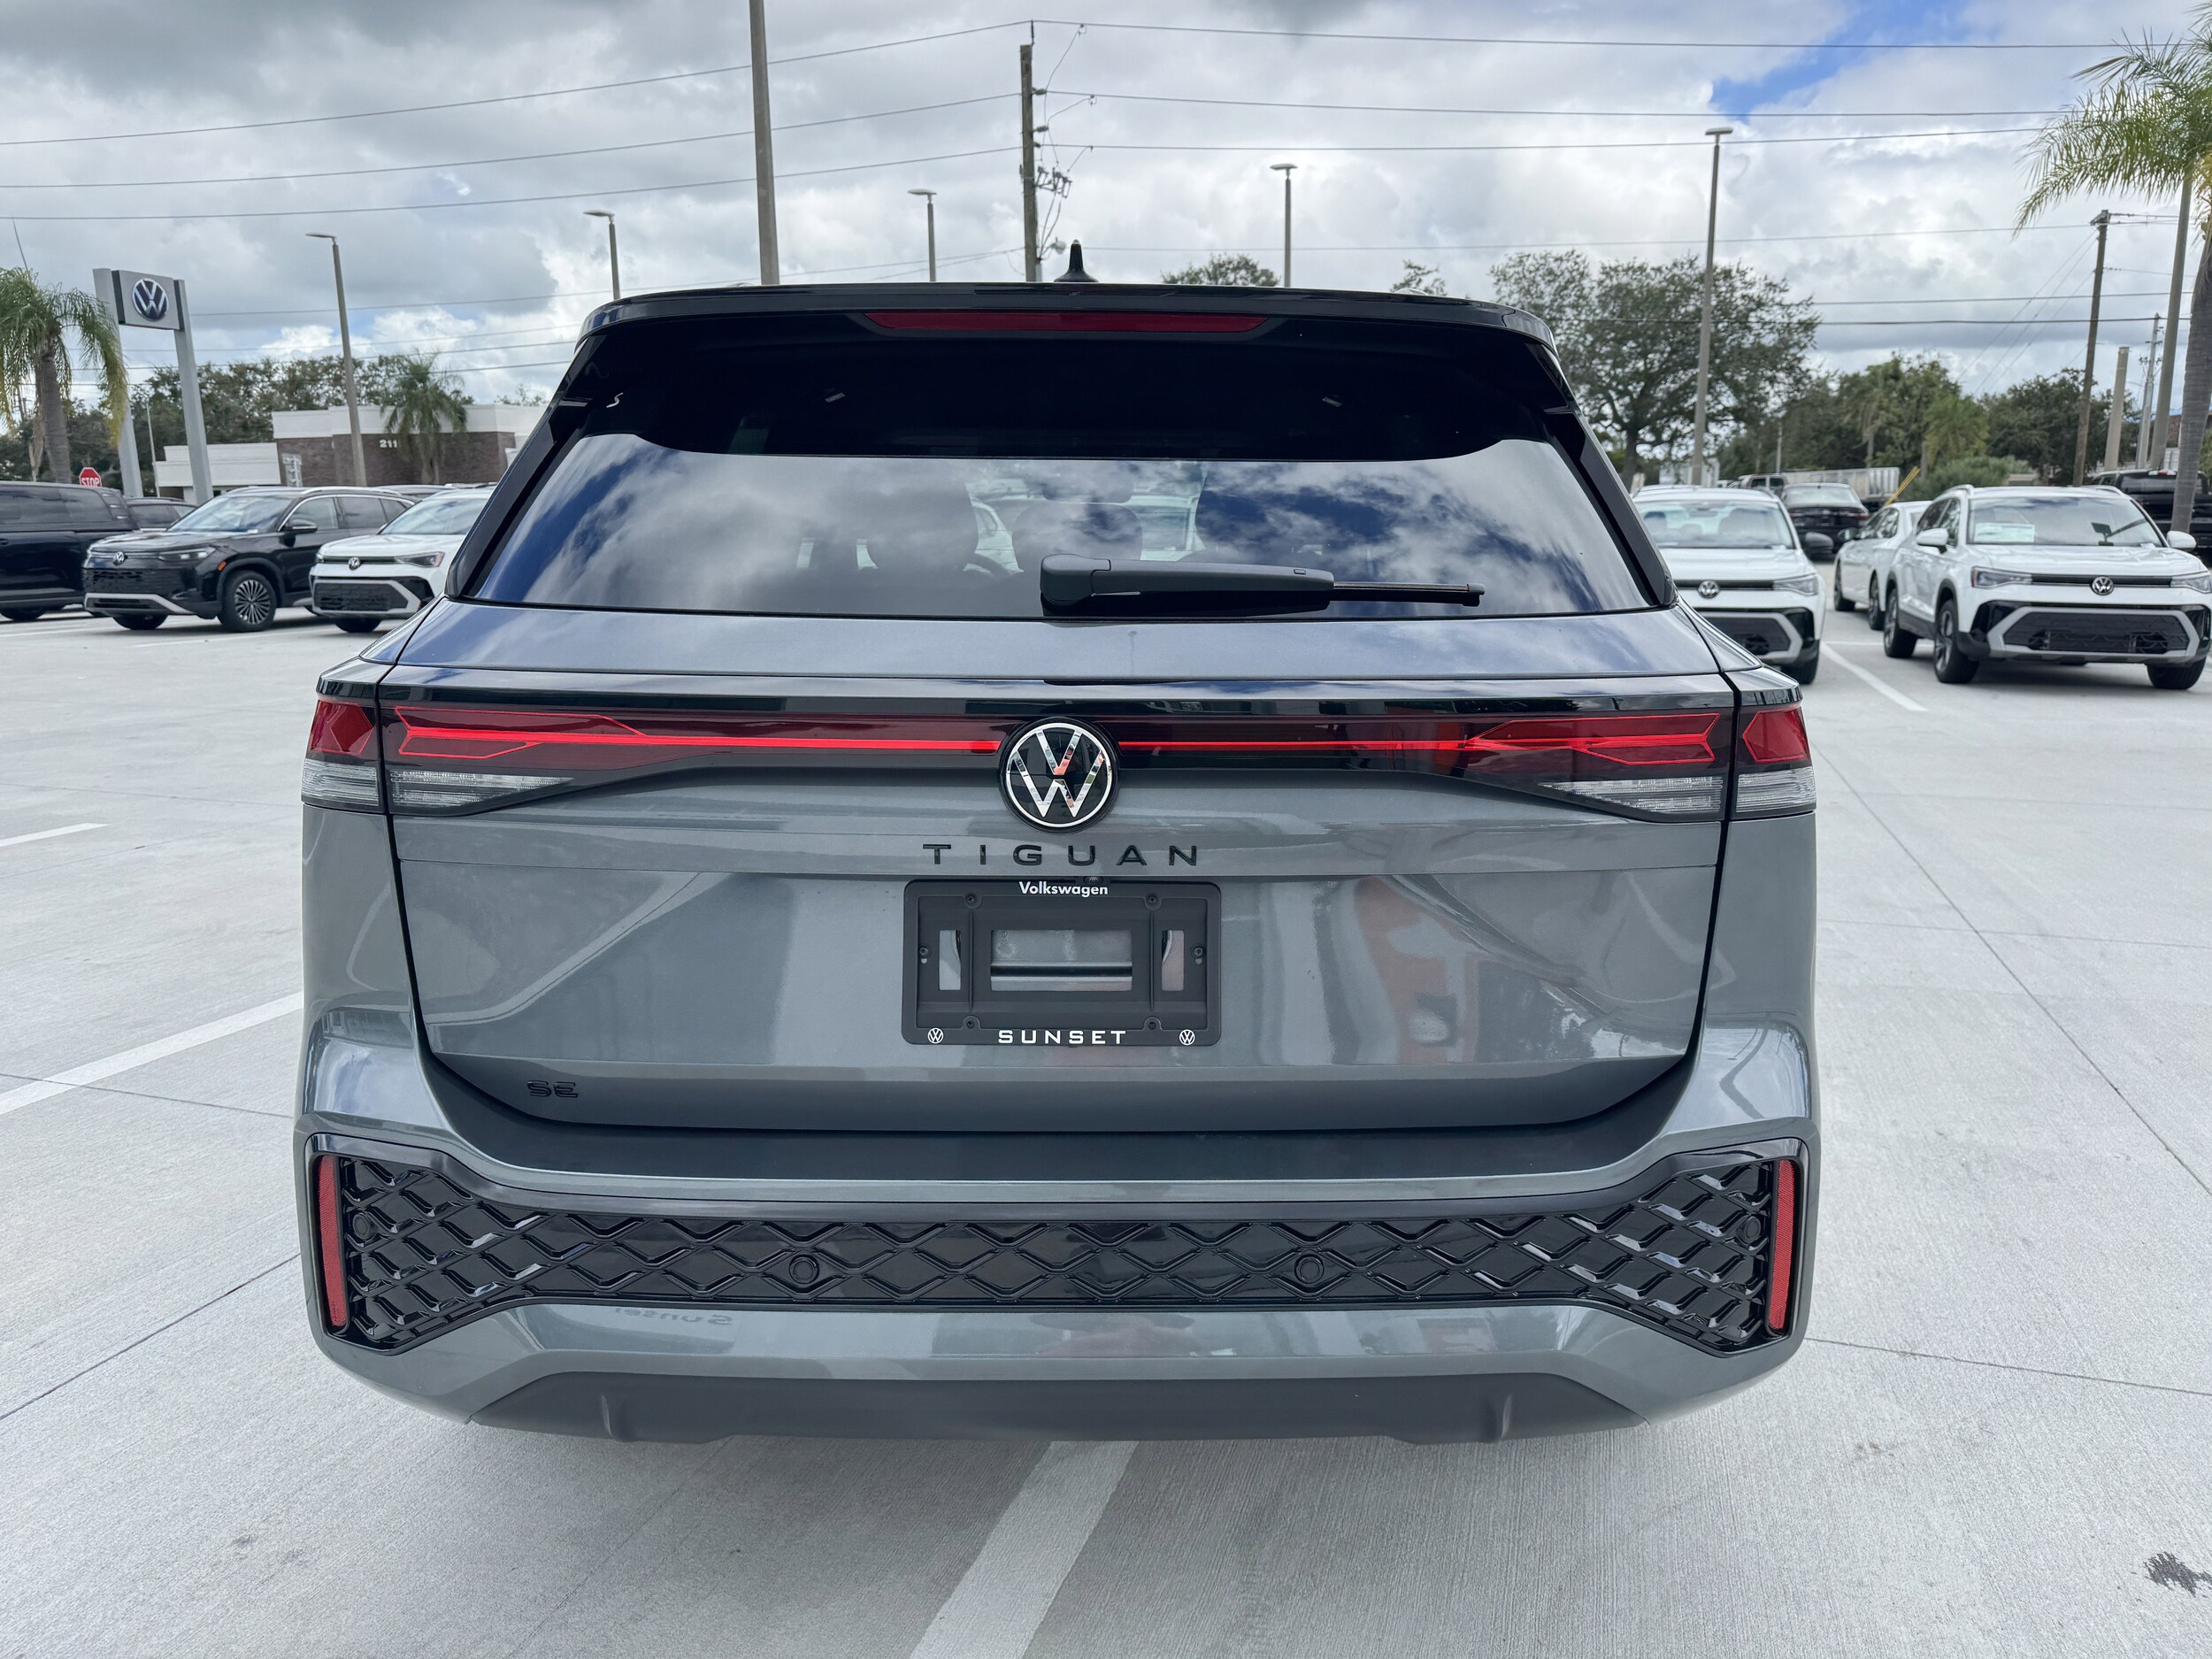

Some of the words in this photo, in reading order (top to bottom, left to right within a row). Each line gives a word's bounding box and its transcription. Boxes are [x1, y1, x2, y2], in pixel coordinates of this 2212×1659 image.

[132, 278, 169, 321] VW
[379, 439, 398, 449] 211
[81, 477, 100, 487] STOP
[1006, 722, 1112, 827] VW
[922, 843, 1197, 866] TIGUAN
[1018, 880, 1109, 898] Volkswagen
[998, 1029, 1126, 1045] SUNSET
[526, 1079, 579, 1098] SE
